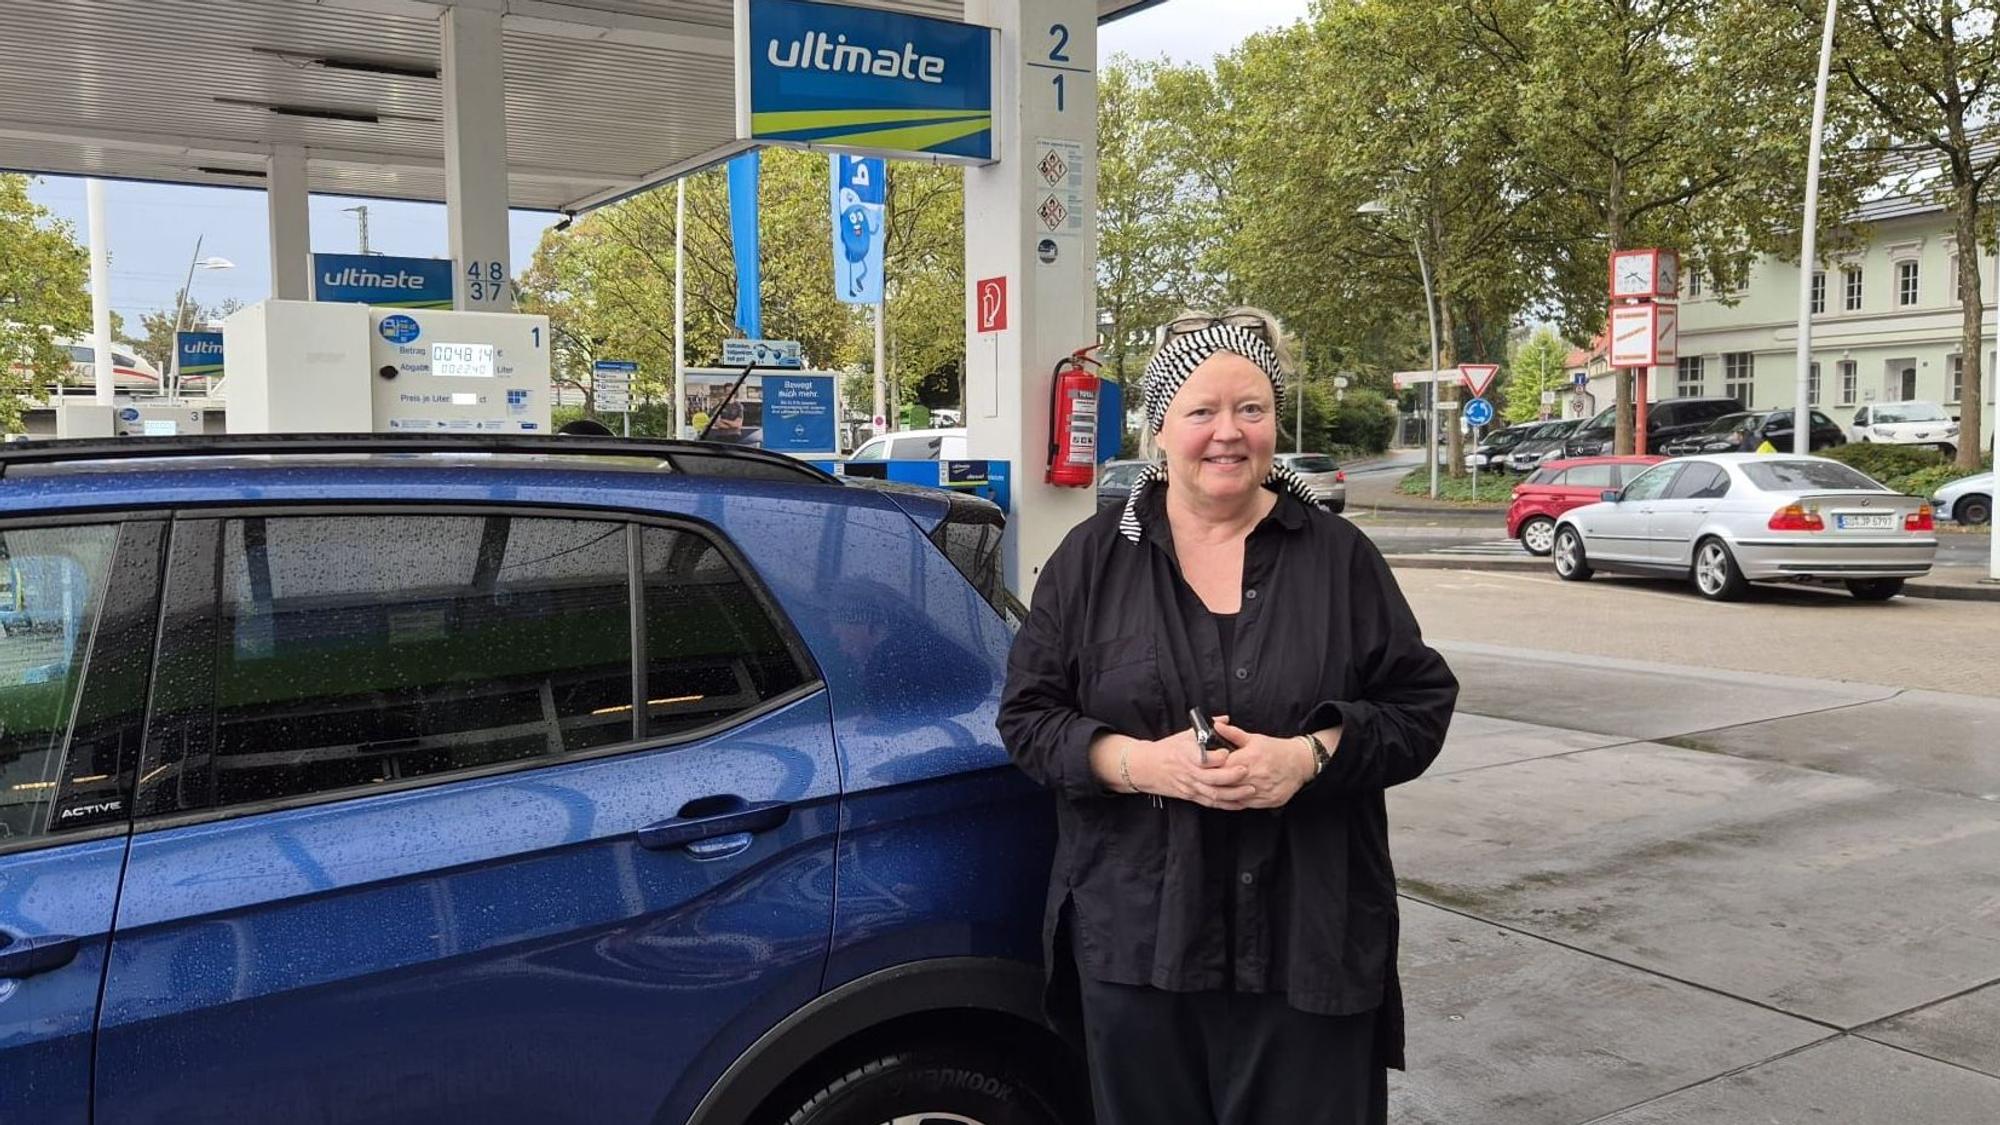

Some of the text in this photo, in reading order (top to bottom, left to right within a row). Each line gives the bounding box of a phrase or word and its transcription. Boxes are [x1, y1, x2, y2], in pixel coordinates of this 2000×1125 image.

[1049, 24, 1070, 62] 2
[767, 30, 946, 84] ultimate
[1052, 73, 1065, 112] 1
[324, 268, 425, 289] ultimate
[467, 261, 503, 280] 4 8
[470, 282, 501, 301] 3 7
[531, 326, 540, 348] 1
[400, 362, 430, 373] Abgabe
[497, 366, 513, 374] Liter
[400, 394, 420, 403] Preis
[422, 394, 431, 405] je
[432, 394, 450, 403] Liter
[191, 411, 199, 422] 3
[62, 801, 121, 818] ACTIVE
